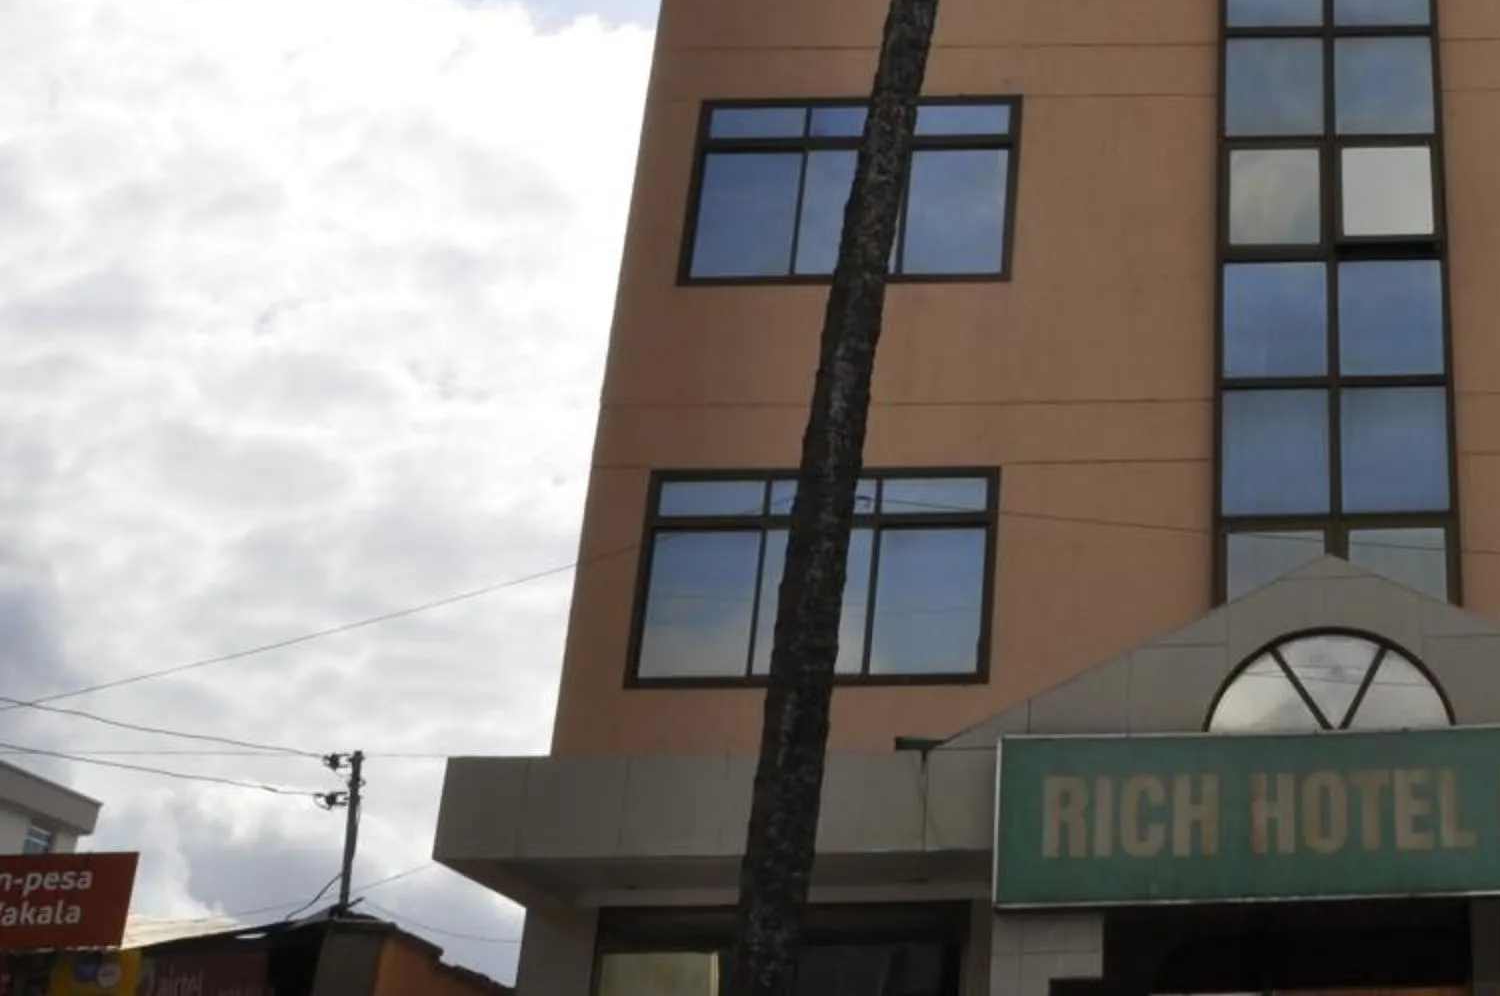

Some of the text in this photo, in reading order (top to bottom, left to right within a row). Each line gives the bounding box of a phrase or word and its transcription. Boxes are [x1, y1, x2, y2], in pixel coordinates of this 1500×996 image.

[1042, 772, 1218, 858] RICH
[1250, 766, 1476, 854] HOTEL
[0, 899, 82, 926] akala
